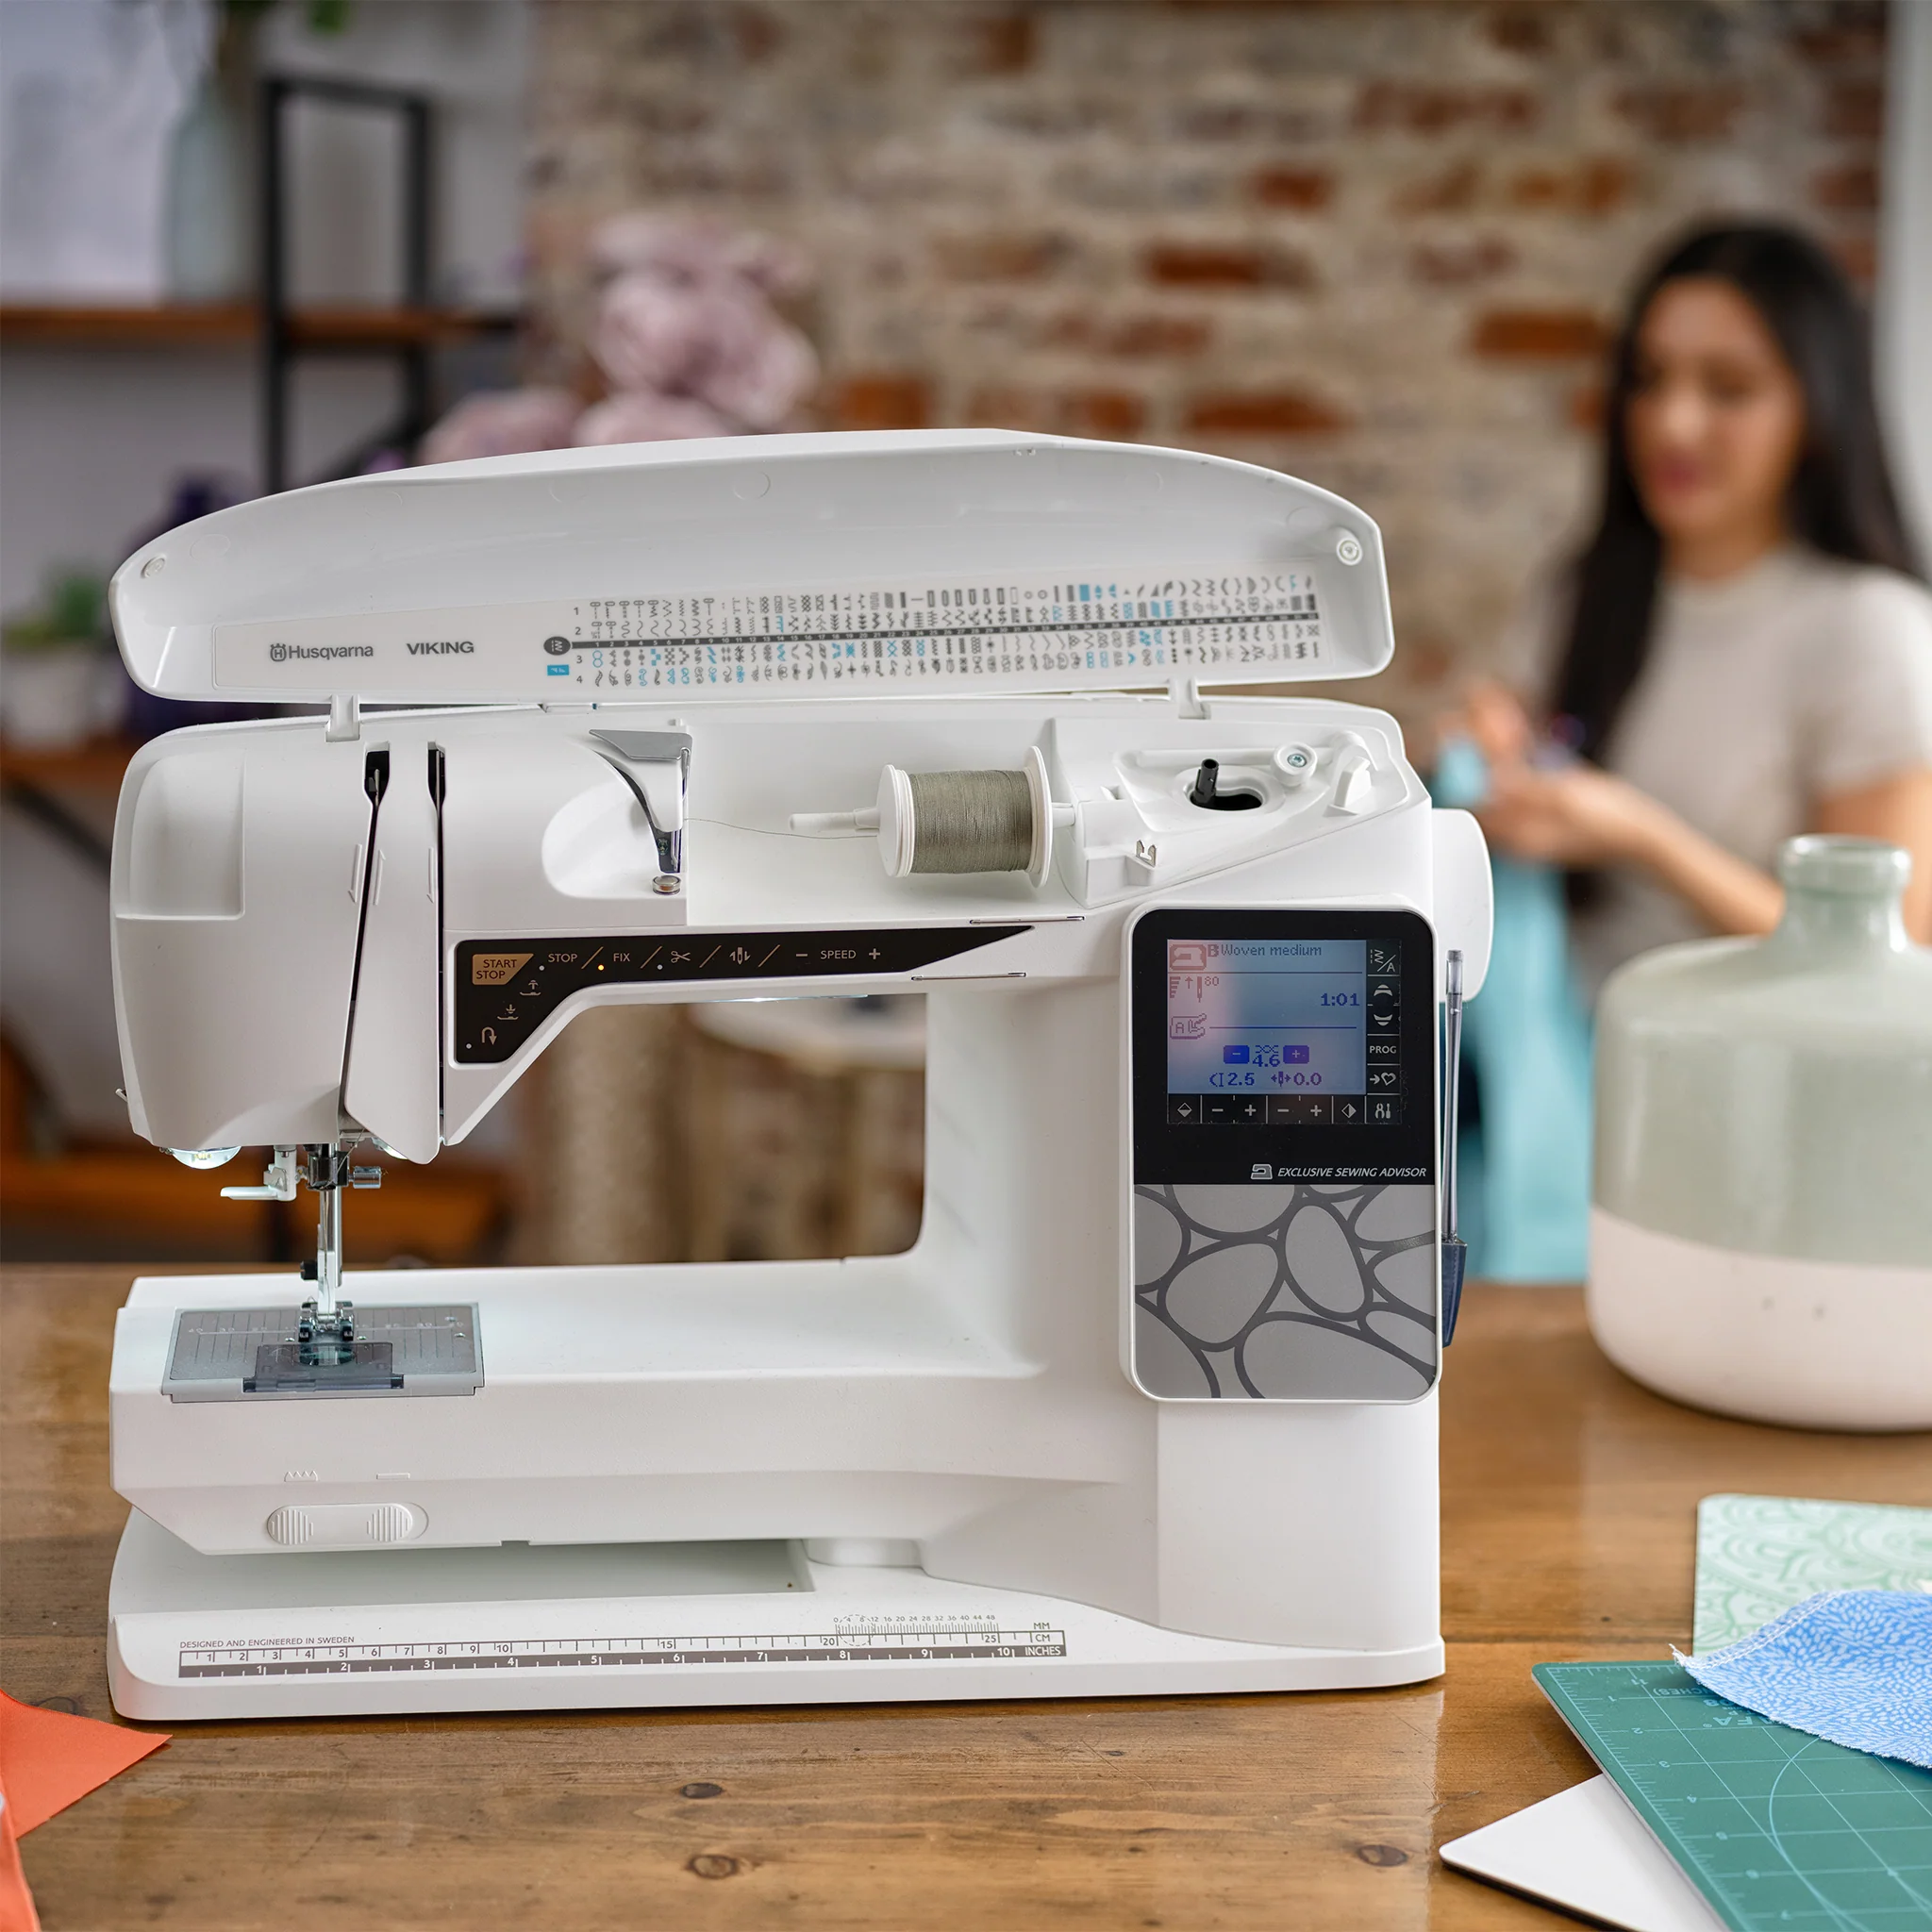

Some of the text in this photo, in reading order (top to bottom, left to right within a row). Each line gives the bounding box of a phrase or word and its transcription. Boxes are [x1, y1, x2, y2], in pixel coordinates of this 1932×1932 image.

[574, 607, 579, 615] 1
[575, 626, 581, 636] 2
[289, 645, 374, 660] Husqvarna
[406, 641, 475, 656] VIKING
[576, 655, 583, 664] 3
[576, 675, 583, 684] 4
[820, 950, 857, 959] SPEED
[1208, 944, 1322, 958] B Woven medium
[548, 954, 578, 963] STOP
[613, 953, 630, 962] FIX
[483, 959, 517, 968] START
[475, 971, 506, 979] STOP
[1204, 976, 1220, 987] 80
[1321, 993, 1359, 1007] 1:01
[1370, 1045, 1397, 1054] PROG
[1252, 1054, 1280, 1067] 4.6
[1228, 1073, 1255, 1085] 2.5
[1293, 1073, 1322, 1085] 0.0
[1277, 1167, 1426, 1177] EXCLUSIVE SEWING ADVISOR
[1034, 1622, 1050, 1630] MM
[179, 1640, 224, 1649] DESIGNED
[225, 1639, 246, 1647] AND
[248, 1638, 303, 1646] ENGINEERED
[317, 1636, 355, 1644] SWEDEN
[207, 1634, 1051, 1662] 1 2 3 4 5 6 7 8 9 10 15 20 25 CM
[257, 1646, 1061, 1674] 1 2 3 4 5 6 7 8 9 10 INCHES
